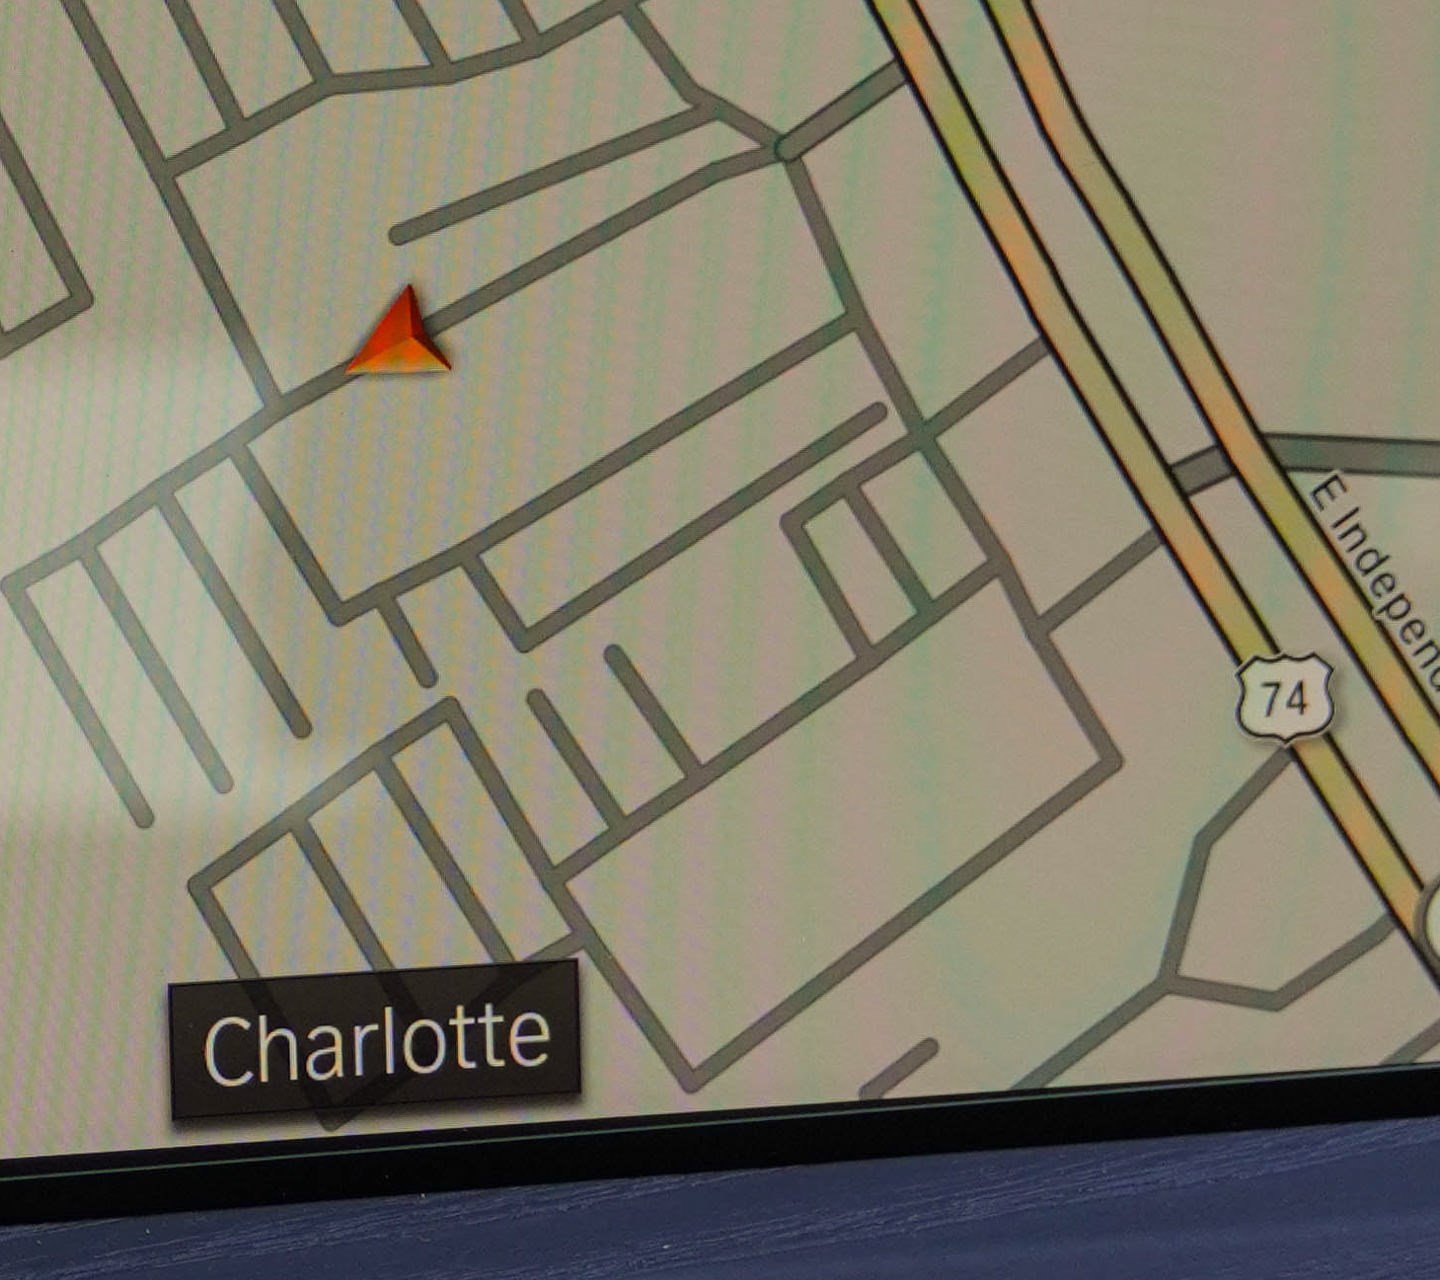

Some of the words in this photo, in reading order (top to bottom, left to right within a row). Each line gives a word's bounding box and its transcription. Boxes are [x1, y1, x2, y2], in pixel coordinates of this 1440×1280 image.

[1310, 473, 1348, 512] E
[1260, 679, 1310, 718] 74
[204, 1001, 552, 1088] Charlotte
